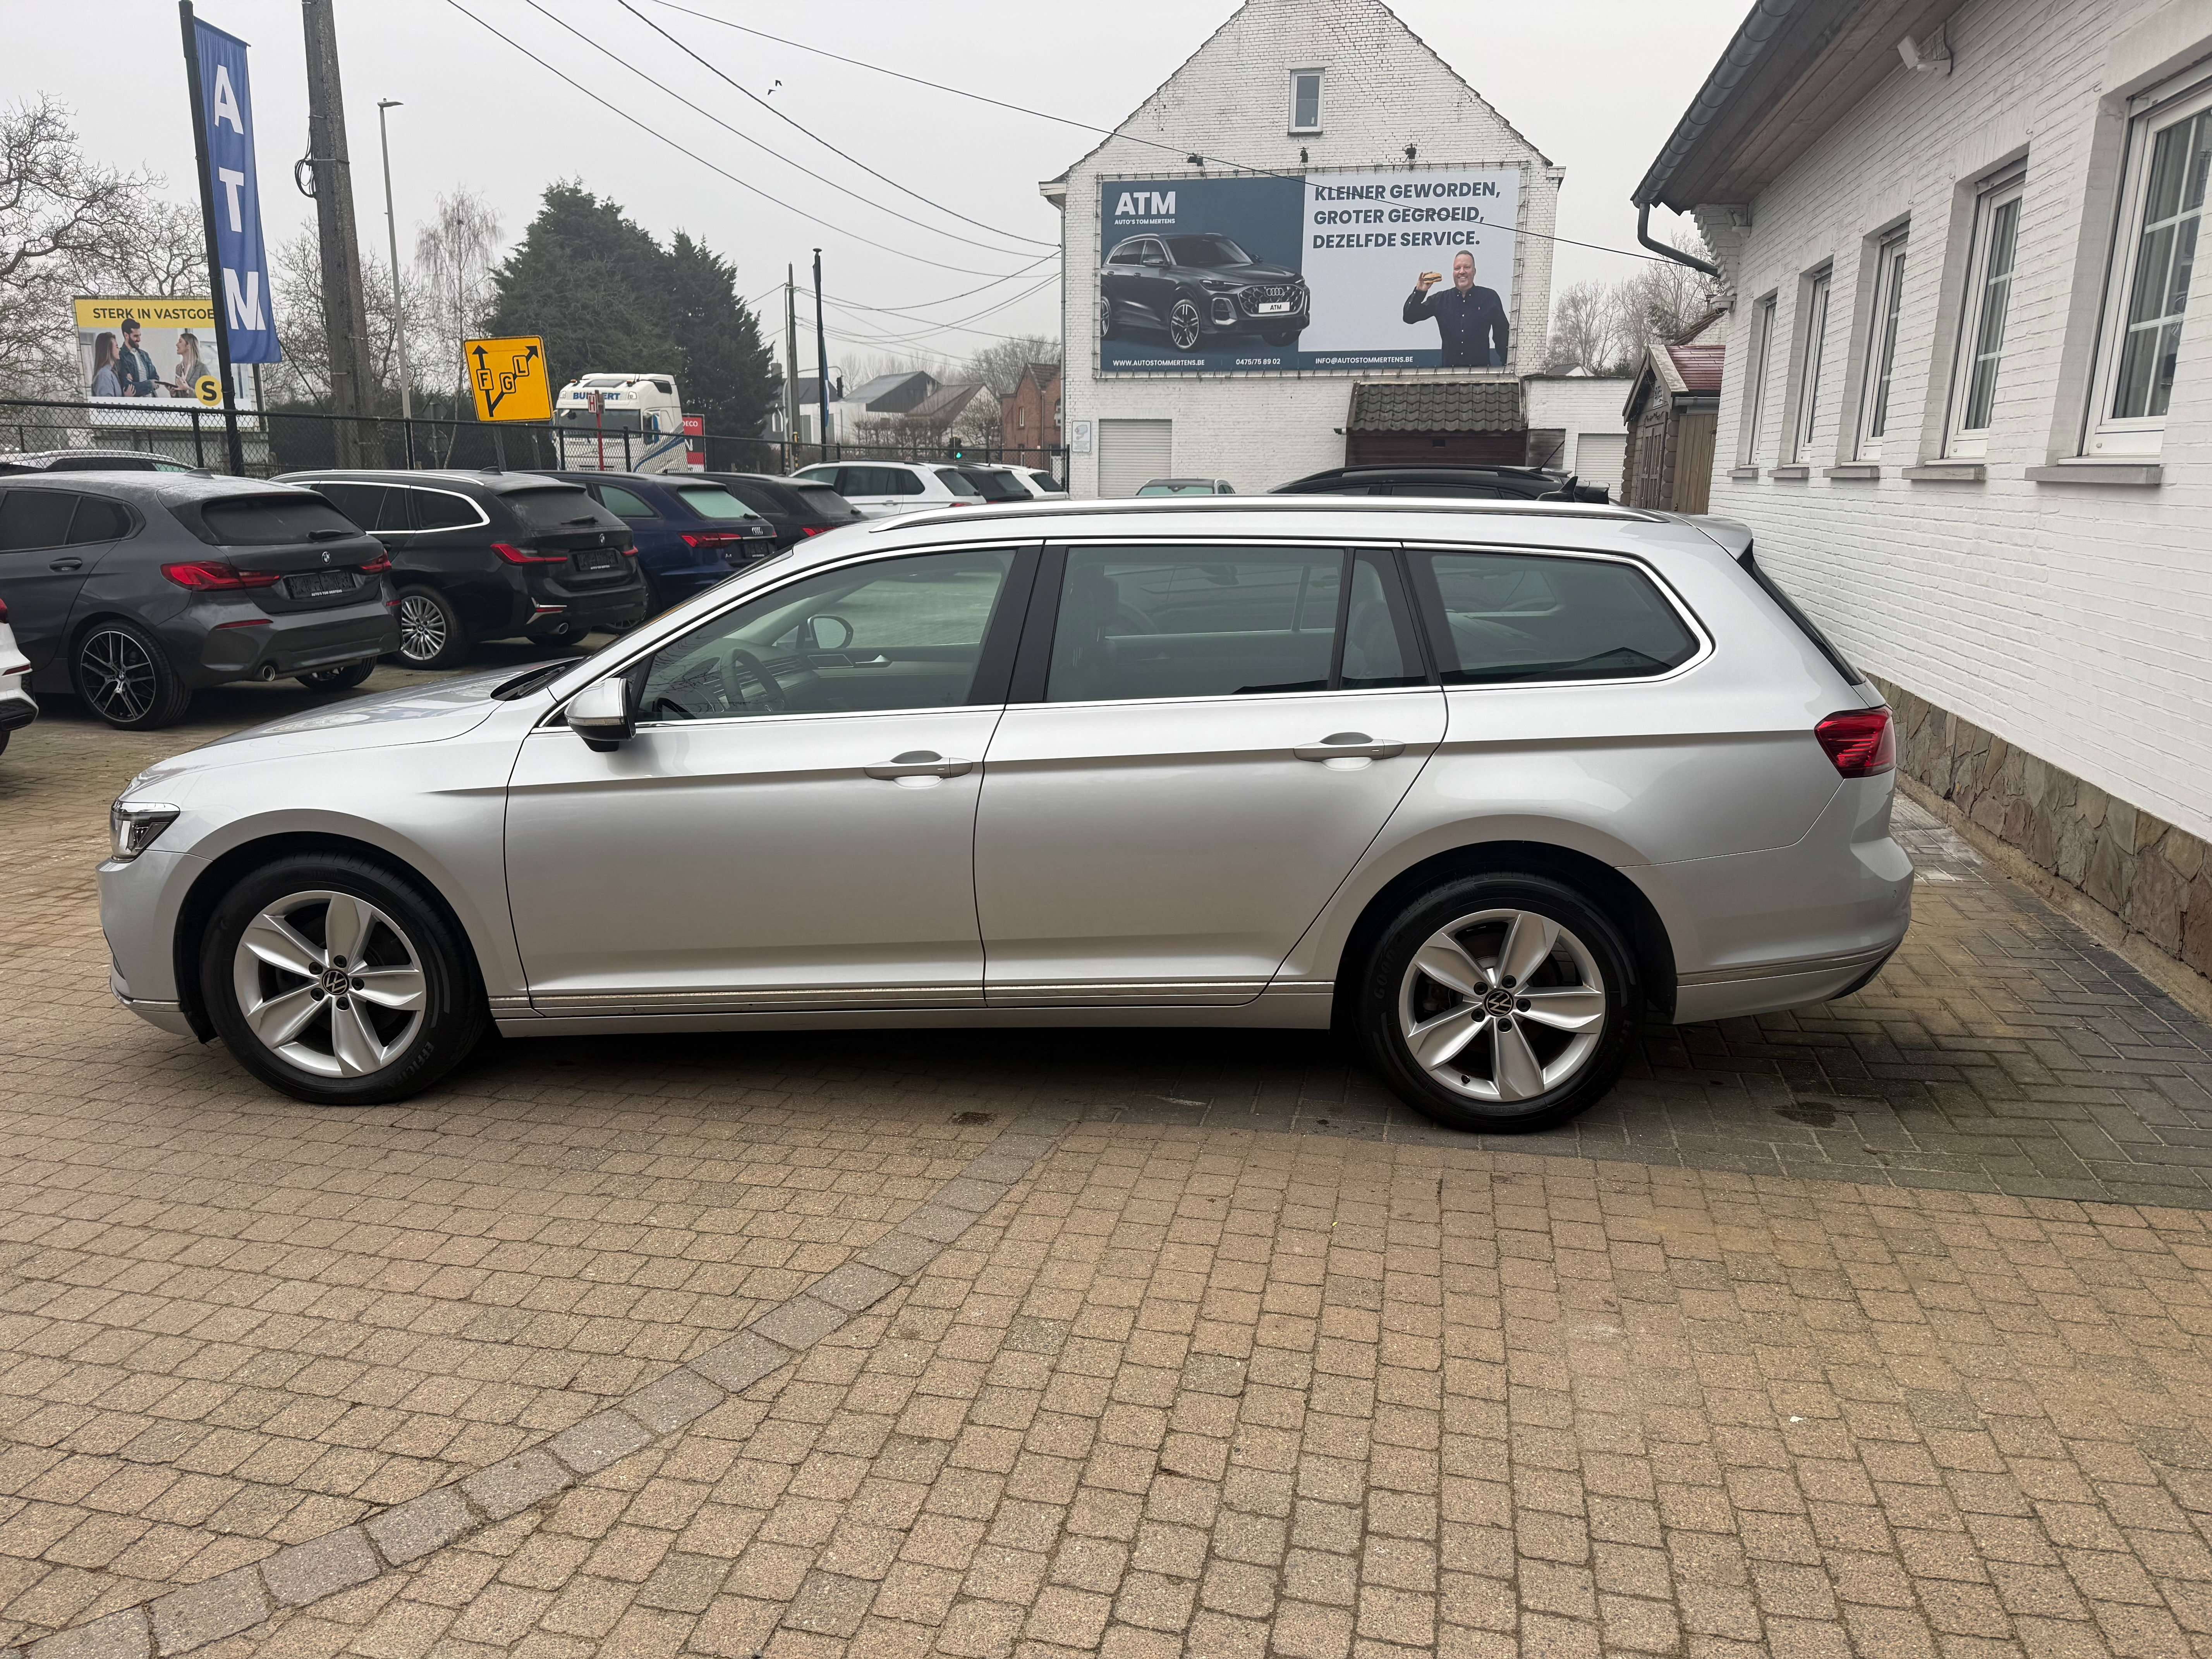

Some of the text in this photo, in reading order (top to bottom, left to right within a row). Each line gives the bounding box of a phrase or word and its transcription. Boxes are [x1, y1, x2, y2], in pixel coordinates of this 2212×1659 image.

[1315, 182, 1501, 201] KLEINER GEWORDEN,
[1115, 191, 1176, 215] ATM
[1314, 206, 1484, 225] GROTER GEGROEID,
[1312, 231, 1480, 249] DEZELFDE SERVICE.
[93, 308, 215, 319] STERK IN VASTGOE
[1315, 356, 1413, 364] INFO@AUTOSTOMMERTENS.BE
[480, 372, 488, 387] F
[503, 375, 513, 390] G
[201, 381, 217, 401] S
